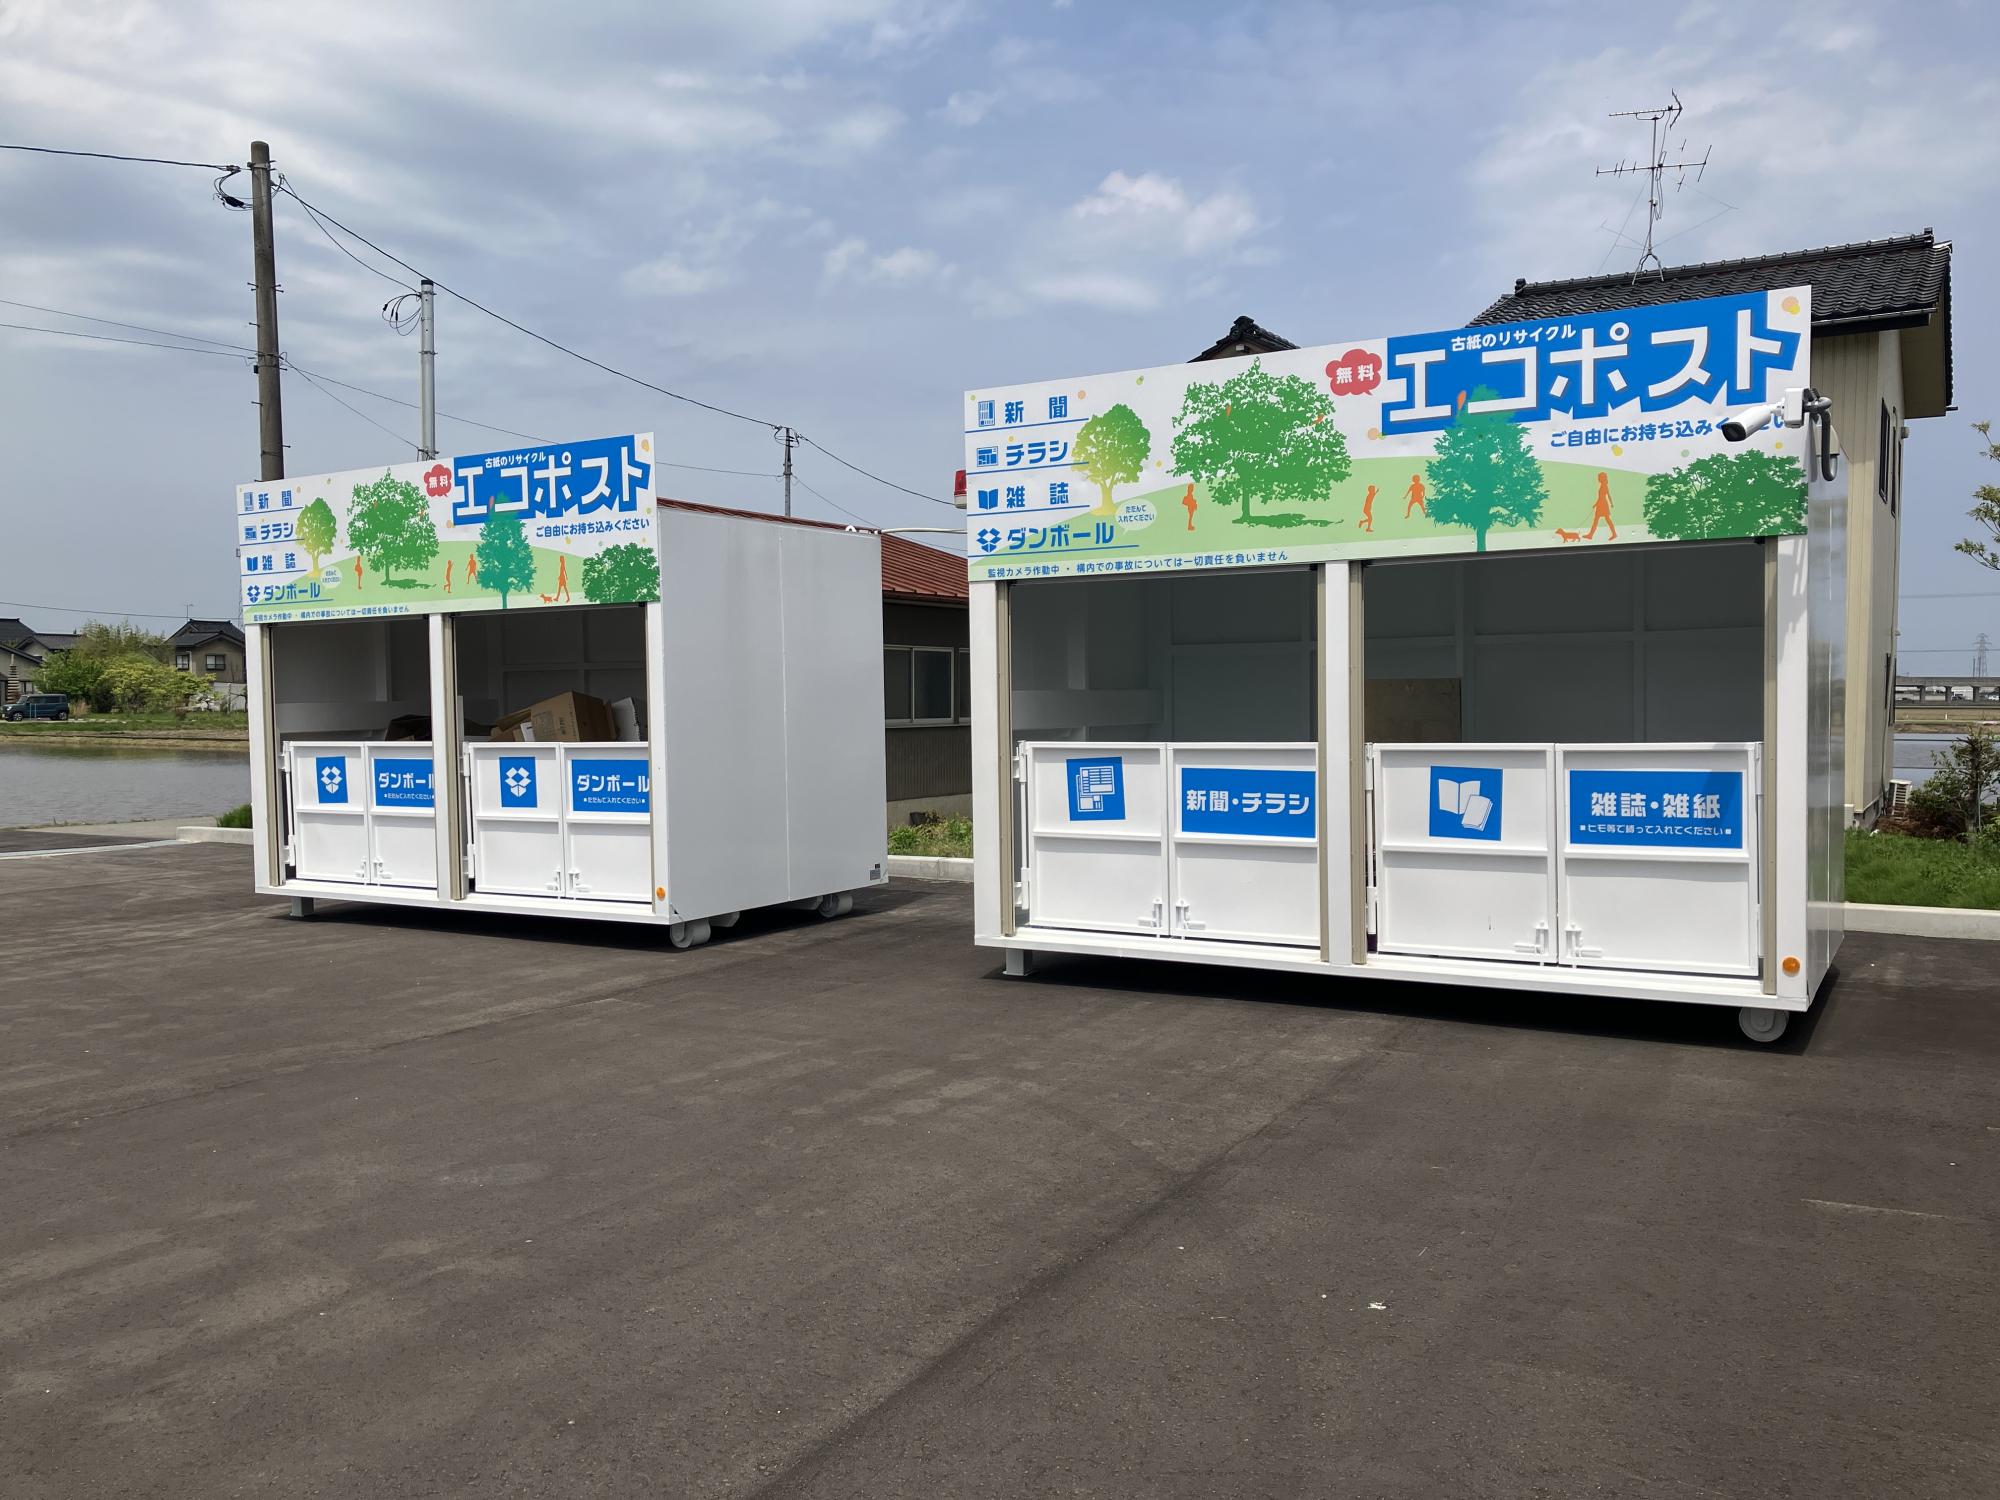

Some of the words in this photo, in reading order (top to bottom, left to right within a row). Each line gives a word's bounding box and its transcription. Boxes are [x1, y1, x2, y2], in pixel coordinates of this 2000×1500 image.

[1451, 324, 1576, 352] 古紙のリサイクル
[1336, 363, 1374, 384] 無料
[1389, 309, 1783, 422] エコポスト
[1005, 396, 1068, 424] 新聞
[485, 452, 546, 469] 古紙のリサイクル
[1006, 441, 1068, 466] チラシ
[428, 475, 448, 489] 無料
[456, 446, 643, 516] エコポスト
[258, 490, 292, 509] 新聞
[1006, 482, 1069, 509] 雑誌
[260, 522, 293, 540] チラシ
[536, 519, 650, 538] ご自由にお持ち込みください
[1118, 514, 1155, 523] 入れてください
[1007, 522, 1114, 550] ダンボール
[987, 565, 1060, 579] 監視カメラ作動中
[1076, 551, 1288, 573] 構内での事故については一切責任を負いません
[263, 582, 320, 601] ダンボール
[577, 774, 650, 792] ダンボール
[1186, 790, 1310, 815] 新聞・チラシ
[1591, 792, 1720, 819] 雑誌・雑紙
